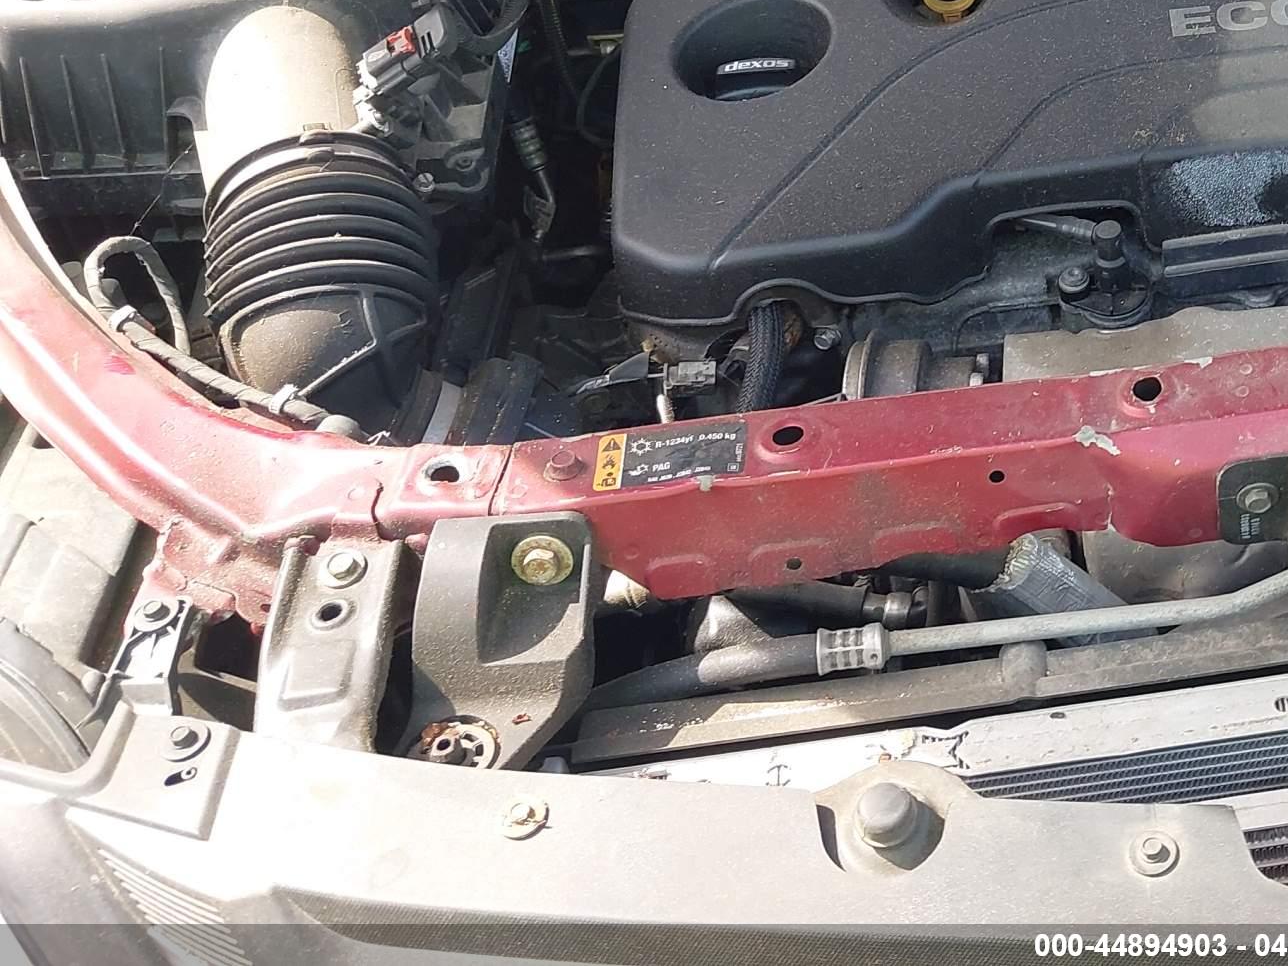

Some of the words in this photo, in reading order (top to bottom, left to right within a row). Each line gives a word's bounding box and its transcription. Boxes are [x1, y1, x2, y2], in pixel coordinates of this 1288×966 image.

[724, 59, 789, 72] dexos
[655, 434, 694, 449] R-1234yf
[724, 432, 737, 442] kg
[652, 461, 671, 472] PAG
